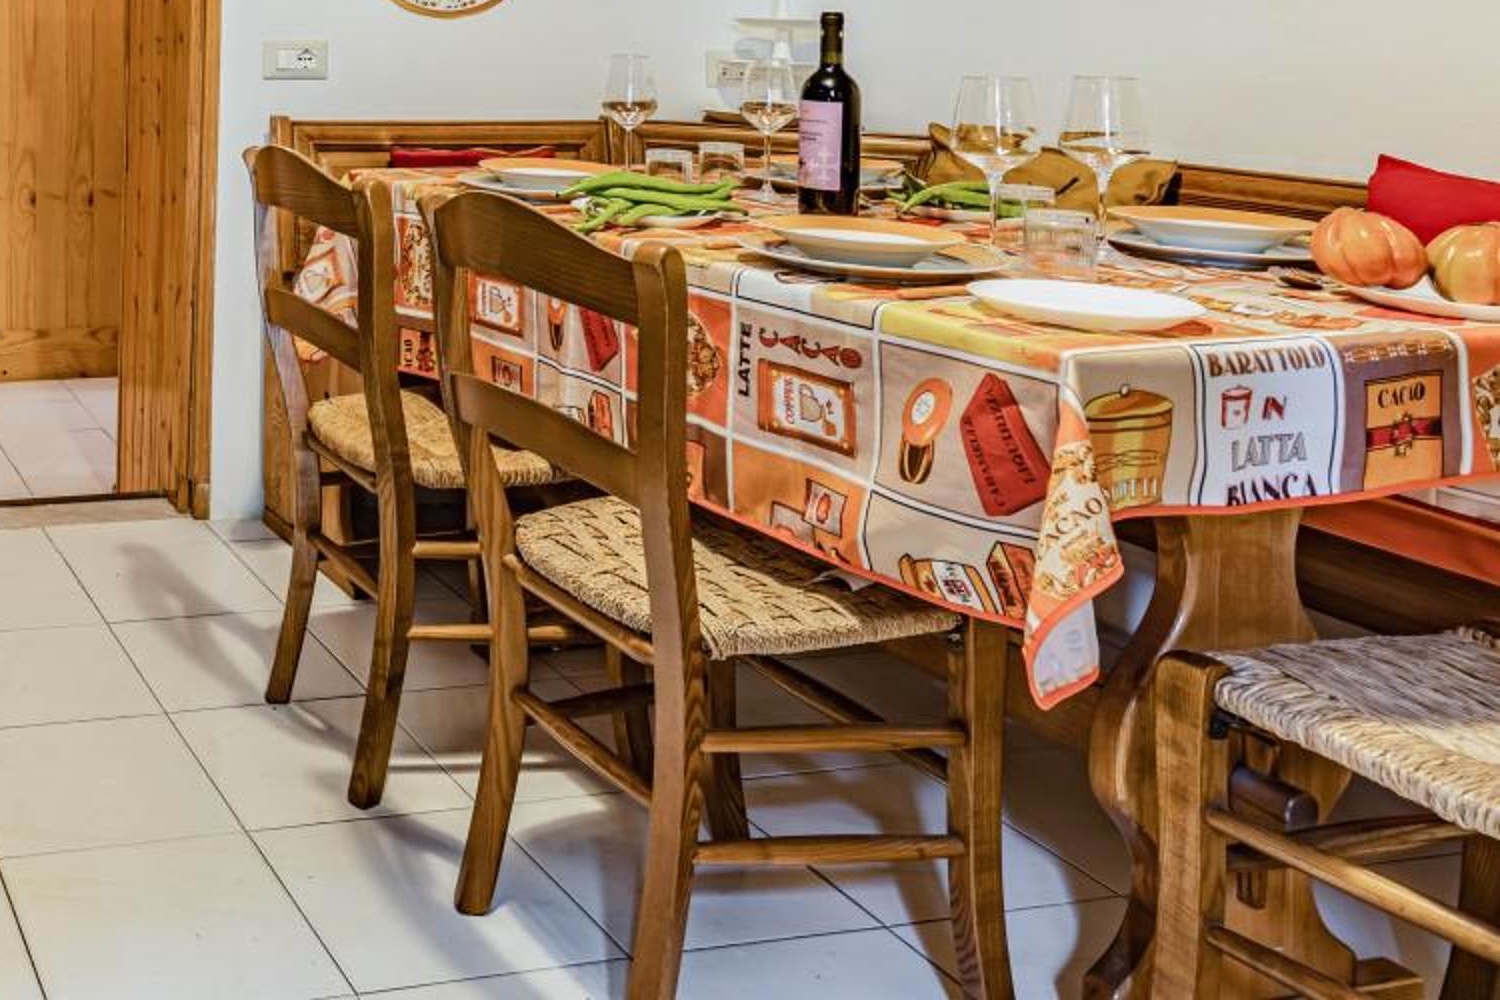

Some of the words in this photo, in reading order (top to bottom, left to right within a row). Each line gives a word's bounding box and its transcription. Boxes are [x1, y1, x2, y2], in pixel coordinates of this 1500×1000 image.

[737, 321, 752, 397] LATTE
[759, 327, 863, 369] CACAO
[1208, 344, 1326, 378] BARATTOLO
[1261, 394, 1288, 420] IN
[1231, 432, 1308, 473] LATTA
[1226, 474, 1318, 507] BIANCA
[1041, 497, 1103, 548] ACAO
